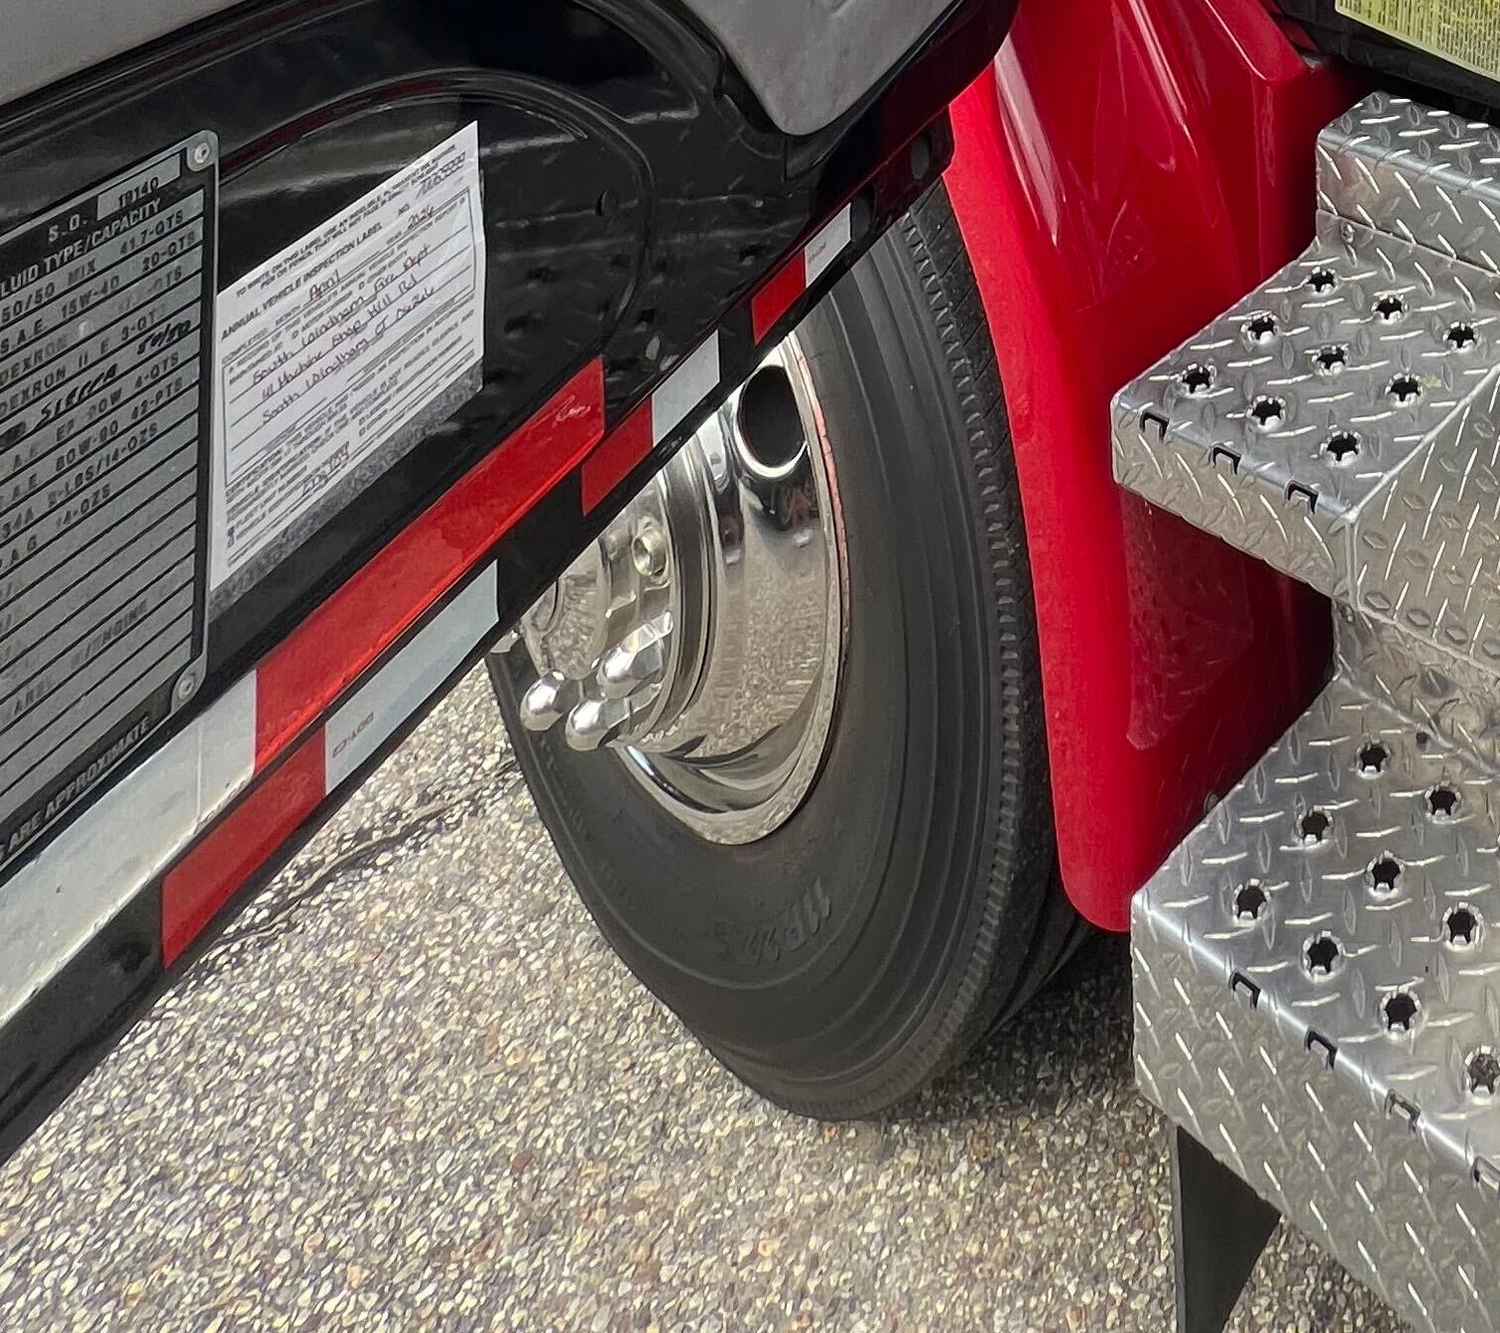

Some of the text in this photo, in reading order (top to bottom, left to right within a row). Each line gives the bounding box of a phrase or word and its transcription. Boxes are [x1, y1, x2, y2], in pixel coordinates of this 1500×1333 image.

[0, 197, 161, 298] LUID TYPE/CAPACITY
[221, 222, 382, 341] ANNUAL VEHICLE INSPECTION LABEL
[309, 270, 339, 306] April
[398, 272, 417, 298] Rd
[1, 282, 55, 323] 50/50
[2, 506, 35, 539] 34A
[7, 716, 151, 855] ARE APPROXIMATE
